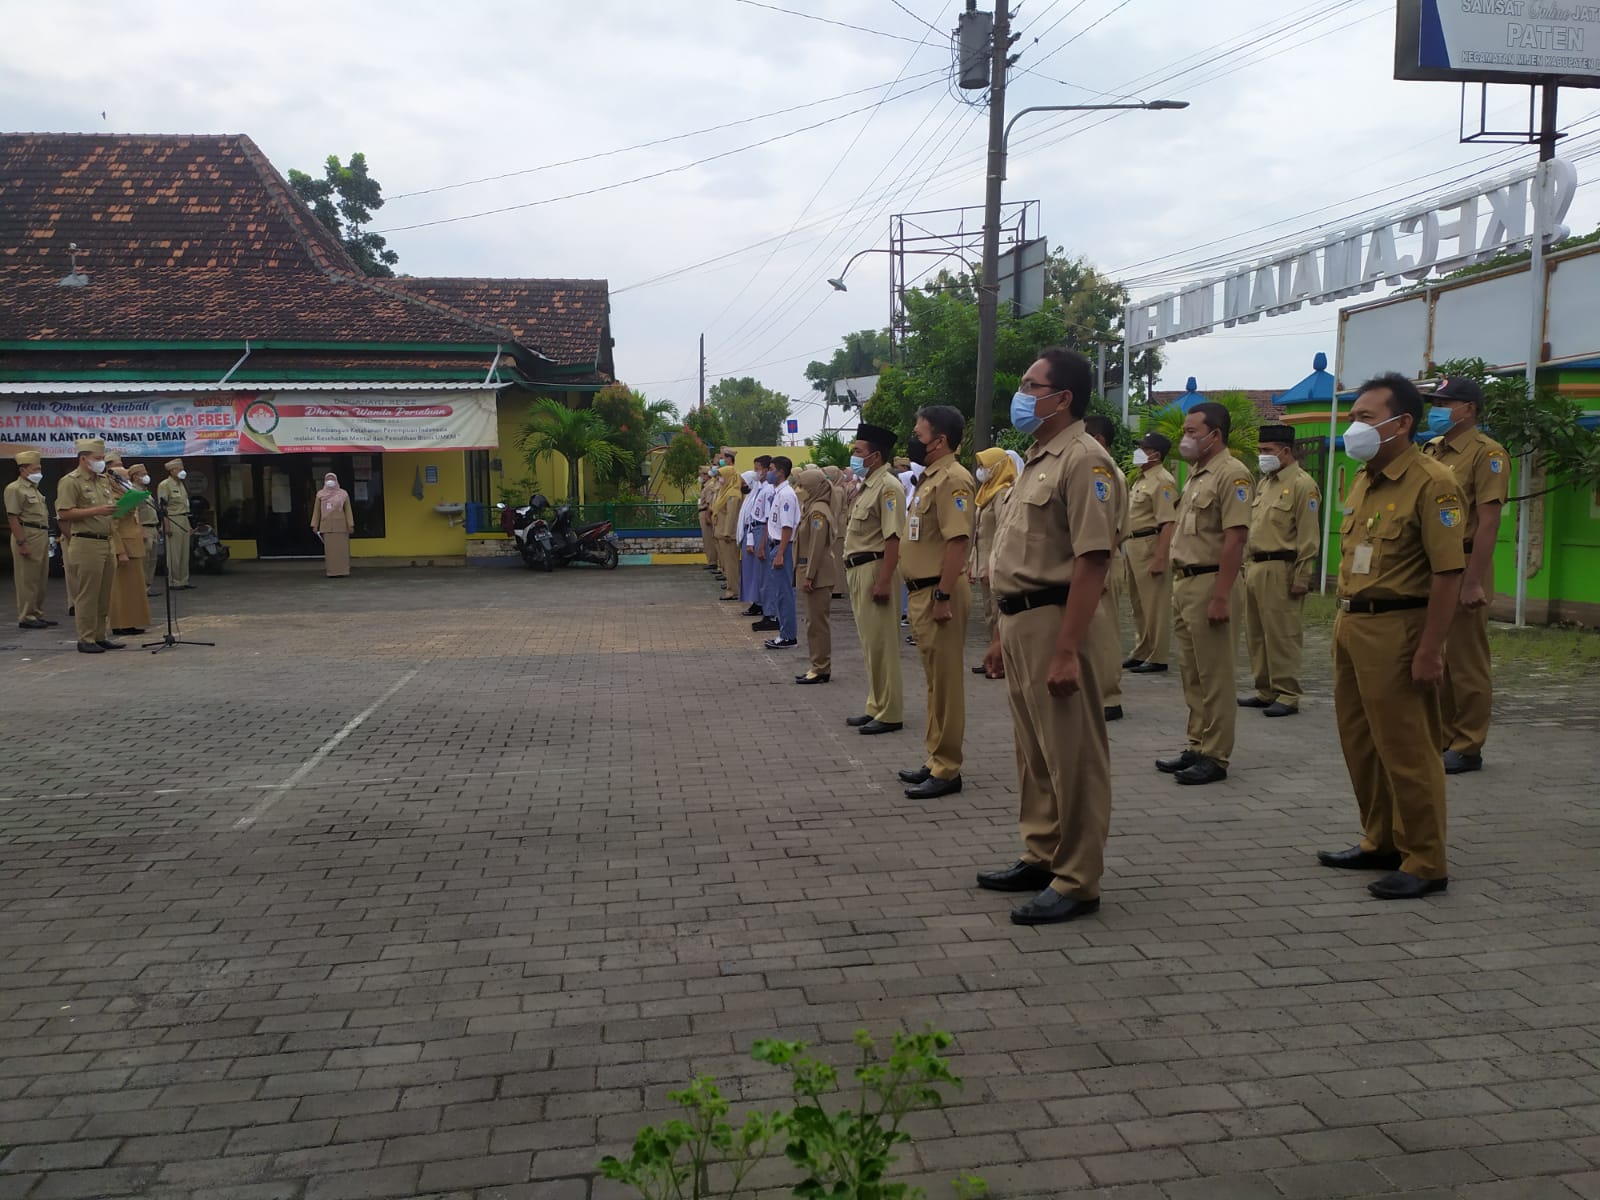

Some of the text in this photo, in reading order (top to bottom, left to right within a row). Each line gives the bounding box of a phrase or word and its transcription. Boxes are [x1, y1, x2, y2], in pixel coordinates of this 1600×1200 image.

[1462, 0, 1524, 16] SAMSAT
[1506, 22, 1585, 51] PATEN
[1462, 50, 1514, 65] KECAMATAN
[1516, 54, 1543, 66] MIJEN
[1544, 55, 1595, 69] KABUPATEN
[16, 401, 151, 413] Telah Dibuka Kembali
[304, 406, 350, 416] Dharma
[25, 415, 74, 428] MALAM
[77, 415, 105, 428] DAN
[109, 415, 163, 428] SAMSAT
[166, 414, 194, 426] CAR
[197, 413, 232, 426] FREE
[1, 432, 47, 442] ALAMAN
[99, 431, 143, 441] SAMSAT
[146, 431, 187, 441] DEMAK
